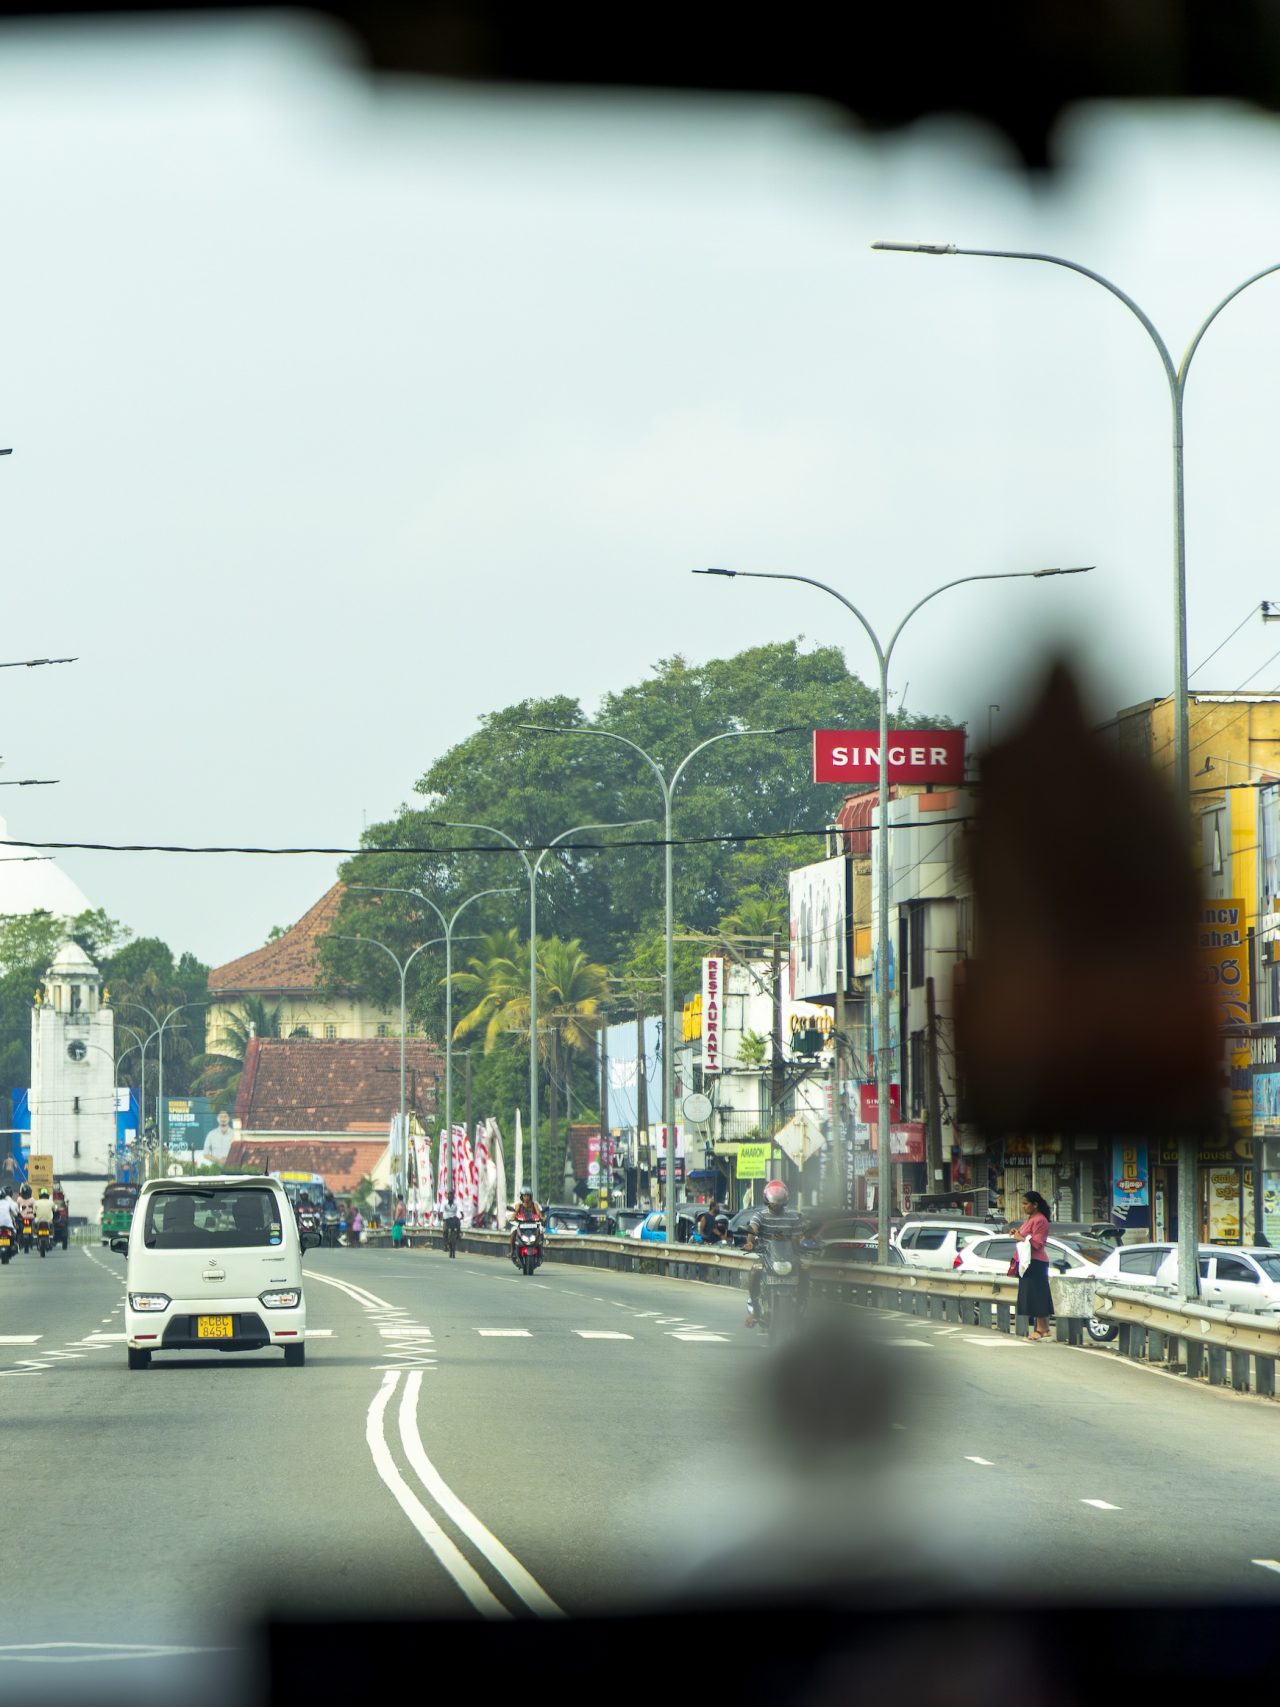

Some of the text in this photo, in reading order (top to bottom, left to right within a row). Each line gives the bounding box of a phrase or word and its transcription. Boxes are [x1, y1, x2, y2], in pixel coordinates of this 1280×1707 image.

[831, 747, 949, 767] SINGER
[707, 961, 718, 1064] RESTAURANT
[203, 1327, 229, 1337] 8451
